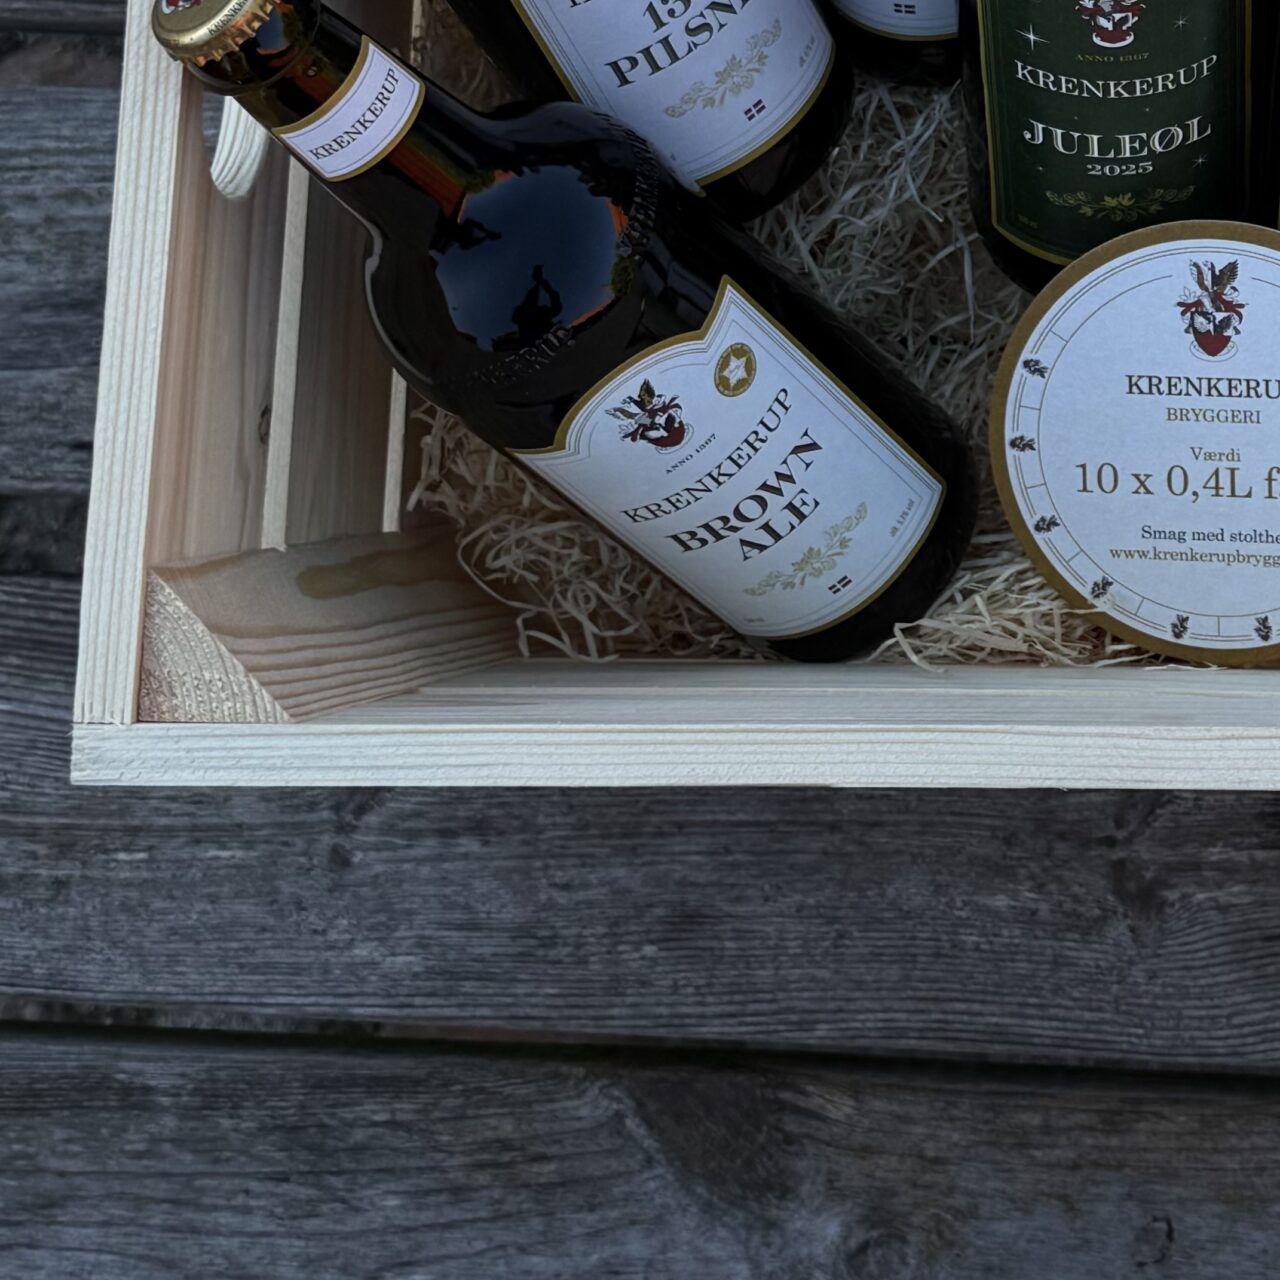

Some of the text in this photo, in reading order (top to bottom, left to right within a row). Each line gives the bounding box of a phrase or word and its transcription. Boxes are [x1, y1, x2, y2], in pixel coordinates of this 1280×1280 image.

[1013, 53, 1219, 100] KRENKERUP
[310, 67, 401, 161] KRENKERUP
[1022, 115, 1213, 160] JULEØL
[1085, 160, 1154, 178] 2025
[1164, 406, 1263, 425] BRYGGERI
[621, 386, 795, 525] KRENKERUP
[664, 451, 695, 476] ANNO
[1189, 445, 1242, 464] Værdi
[663, 427, 824, 554] BROWN
[1074, 461, 1120, 495] 10
[1130, 470, 1155, 497] x
[1165, 463, 1253, 504] 0,4L
[737, 487, 821, 563] ALE
[1140, 524, 1188, 546] Smag
[1190, 526, 1226, 544] med
